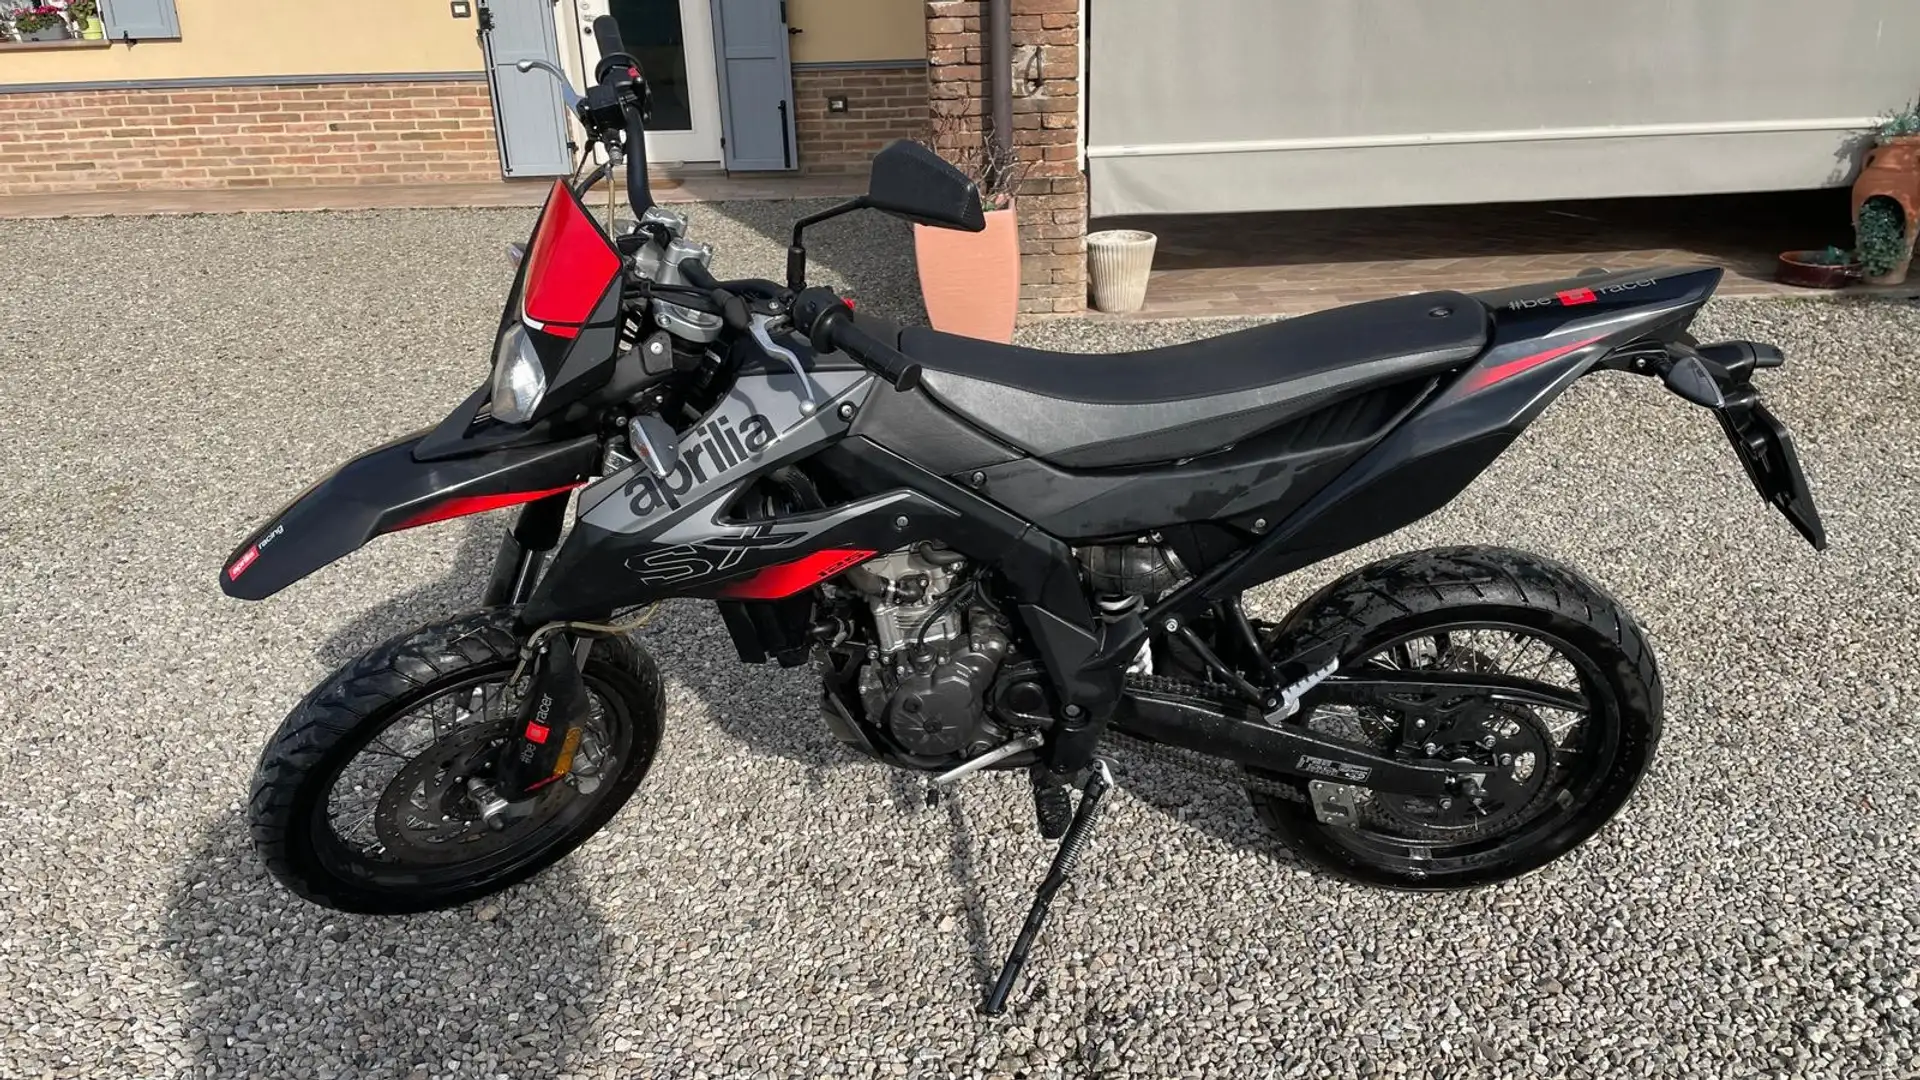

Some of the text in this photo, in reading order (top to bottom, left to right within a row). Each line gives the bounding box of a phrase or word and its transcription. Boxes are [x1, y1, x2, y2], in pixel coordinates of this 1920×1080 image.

[1599, 277, 1657, 295] racer
[624, 413, 779, 517] aprilia
[258, 524, 284, 550] racing
[536, 692, 553, 724] racer
